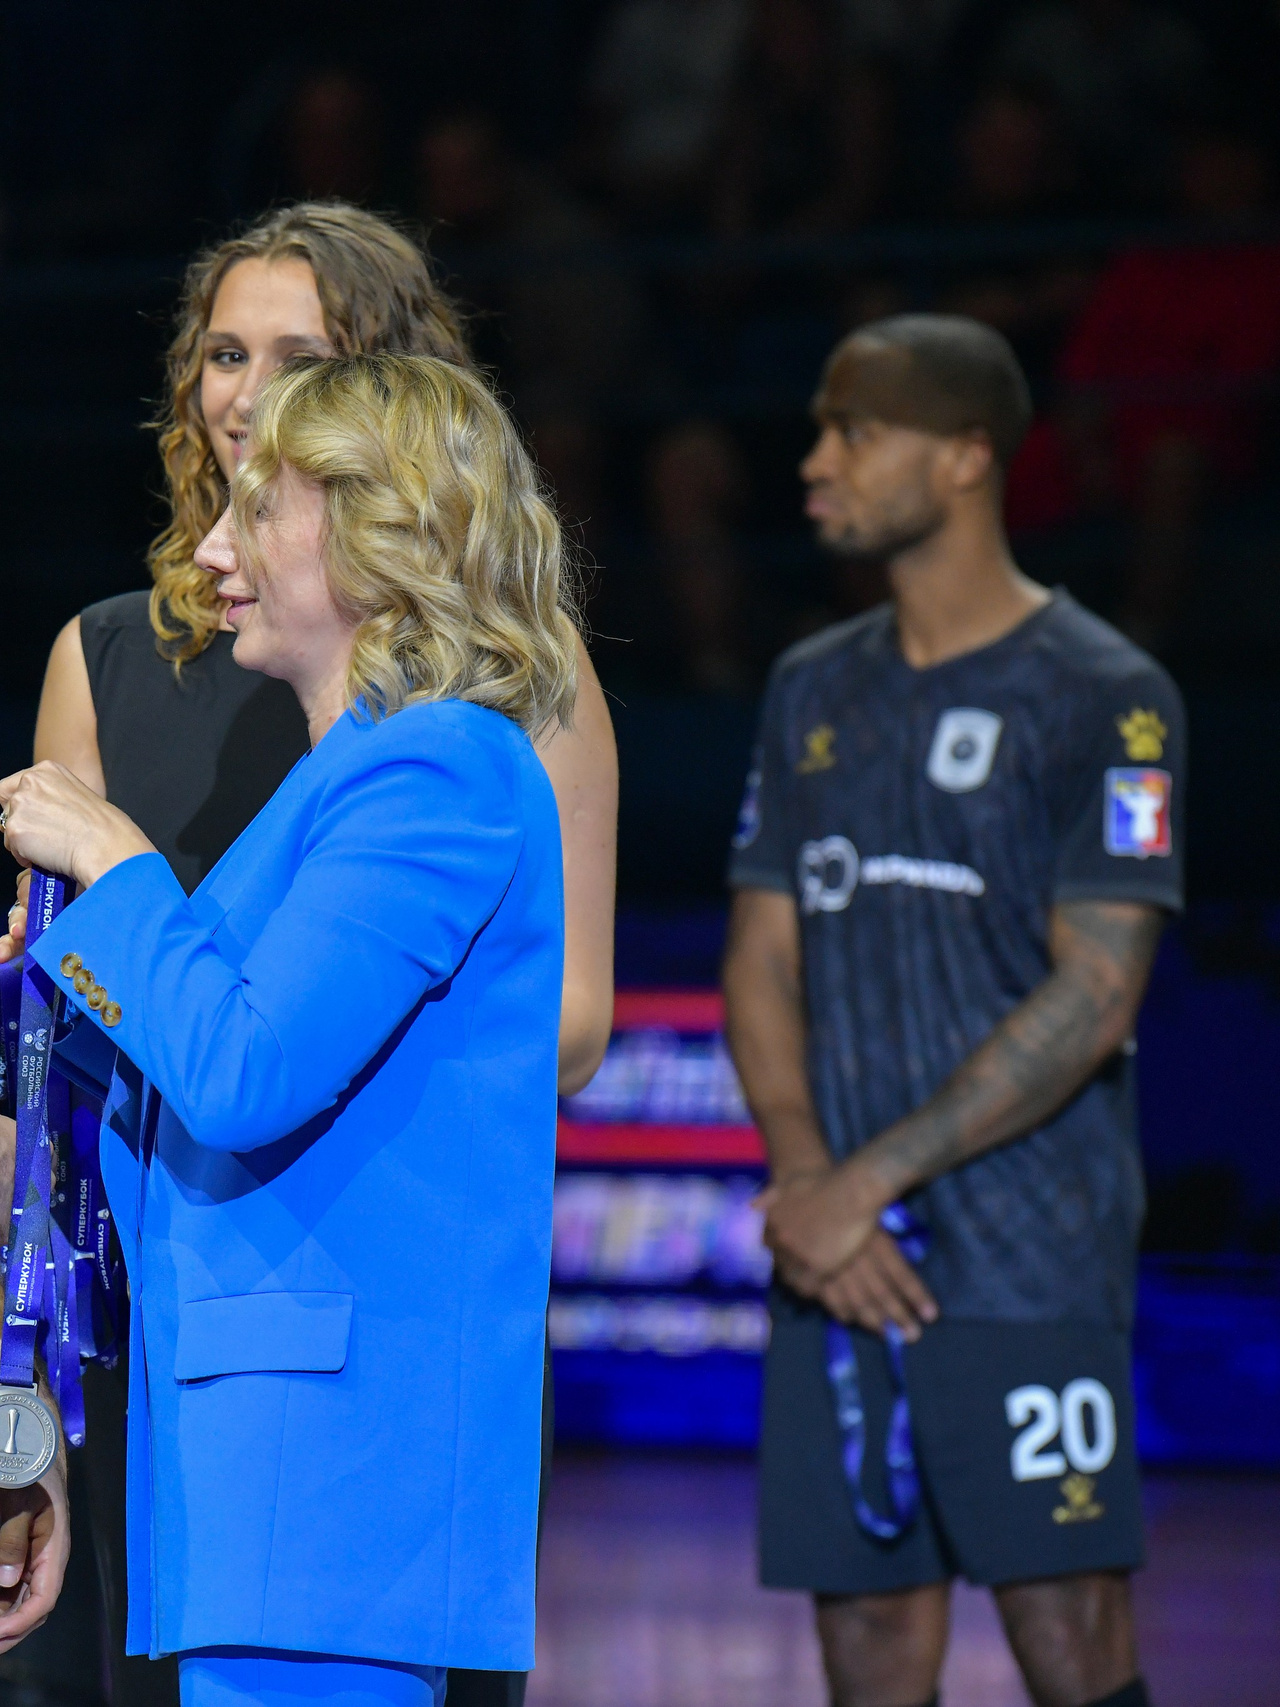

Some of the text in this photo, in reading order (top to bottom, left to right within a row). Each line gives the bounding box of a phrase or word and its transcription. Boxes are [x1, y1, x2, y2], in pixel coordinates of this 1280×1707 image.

[42, 875, 56, 930] ПЕРКУБОК
[21, 1055, 29, 1078] СОЮЗ
[27, 1055, 36, 1110] ФУТБОЛЬНЫЙ
[33, 1056, 43, 1108] РОССИЙСКИЙ
[77, 1178, 88, 1246] СУПЕРКУБОК
[16, 1241, 33, 1312] СУПЕРКУБОК
[97, 1223, 110, 1290] СУПЕРКУБОК
[1003, 1376, 1117, 1483] 20
